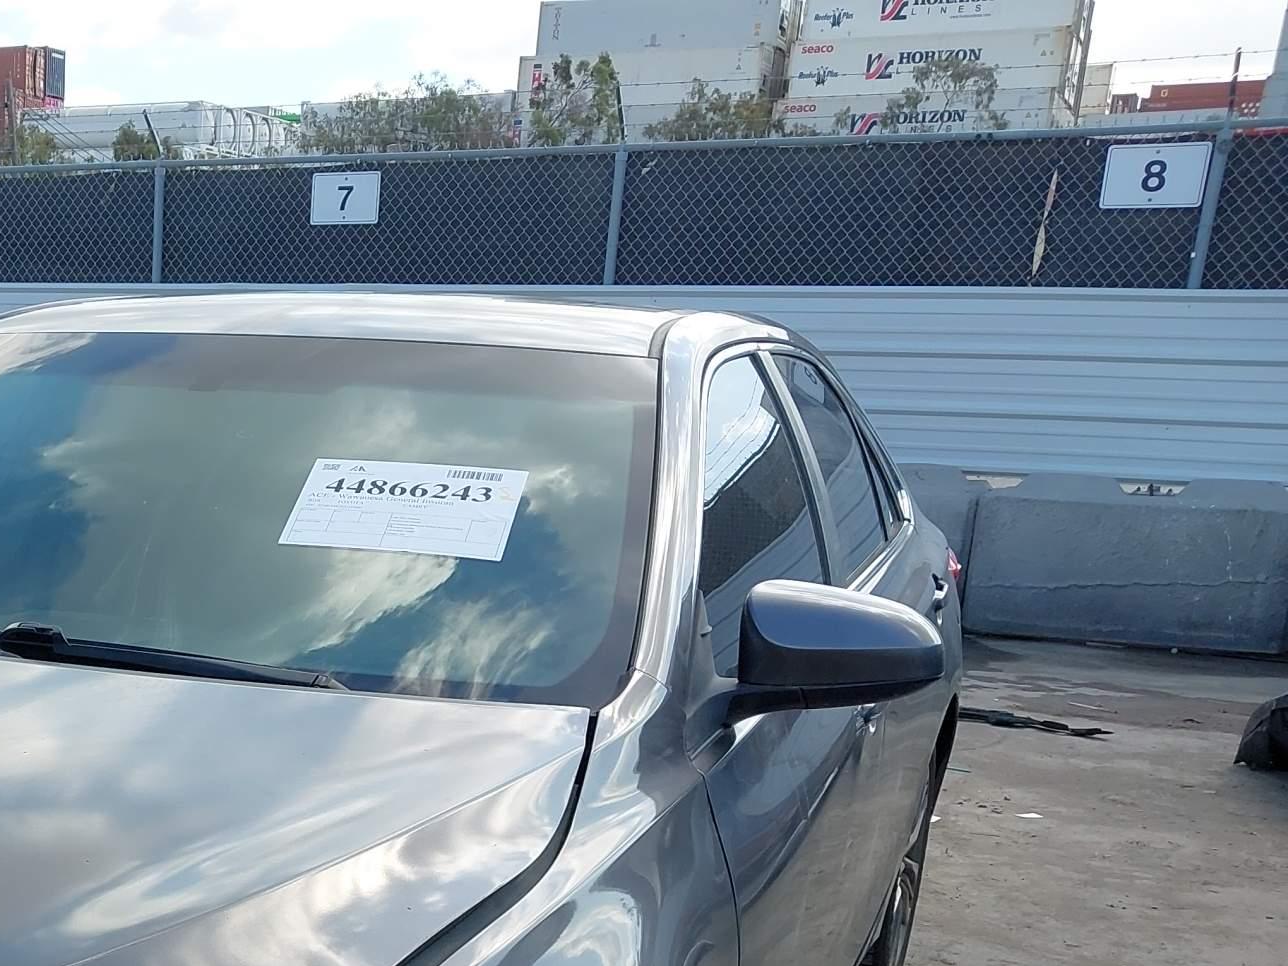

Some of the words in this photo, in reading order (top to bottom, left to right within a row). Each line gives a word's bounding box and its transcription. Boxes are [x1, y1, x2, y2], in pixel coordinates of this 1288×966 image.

[911, 4, 983, 16] LINES
[801, 44, 834, 54] seaco
[784, 103, 817, 114] seaco
[888, 109, 967, 124] ORIZON
[1141, 160, 1167, 192] 8
[338, 186, 354, 211] 7
[325, 478, 493, 502] 44866243
